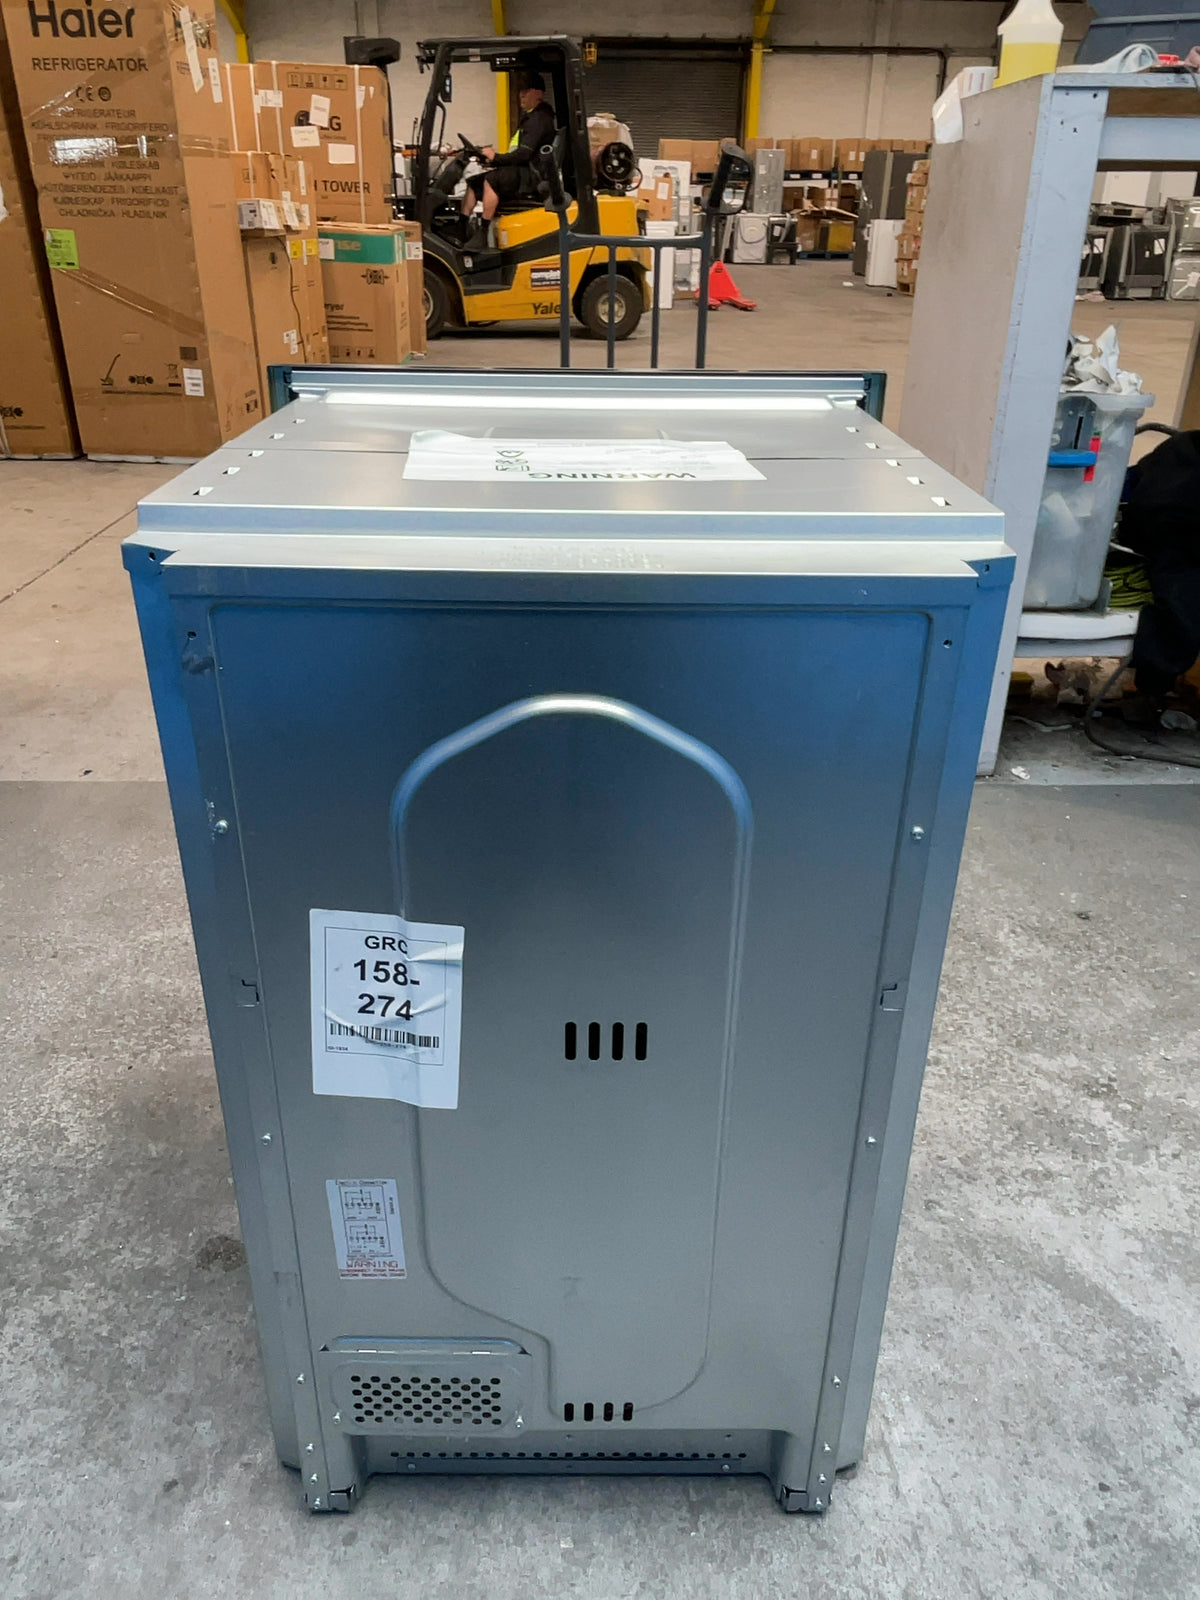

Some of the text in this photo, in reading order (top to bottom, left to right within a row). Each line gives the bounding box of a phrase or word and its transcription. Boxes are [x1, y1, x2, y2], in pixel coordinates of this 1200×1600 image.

[27, 0, 135, 38] Haier
[32, 57, 149, 72] REFRIGERATOR
[321, 180, 371, 194] TOWER
[532, 302, 561, 315] Yale
[353, 959, 420, 987] 158-
[357, 993, 414, 1021] 274
[346, 1260, 399, 1268] WARNING
